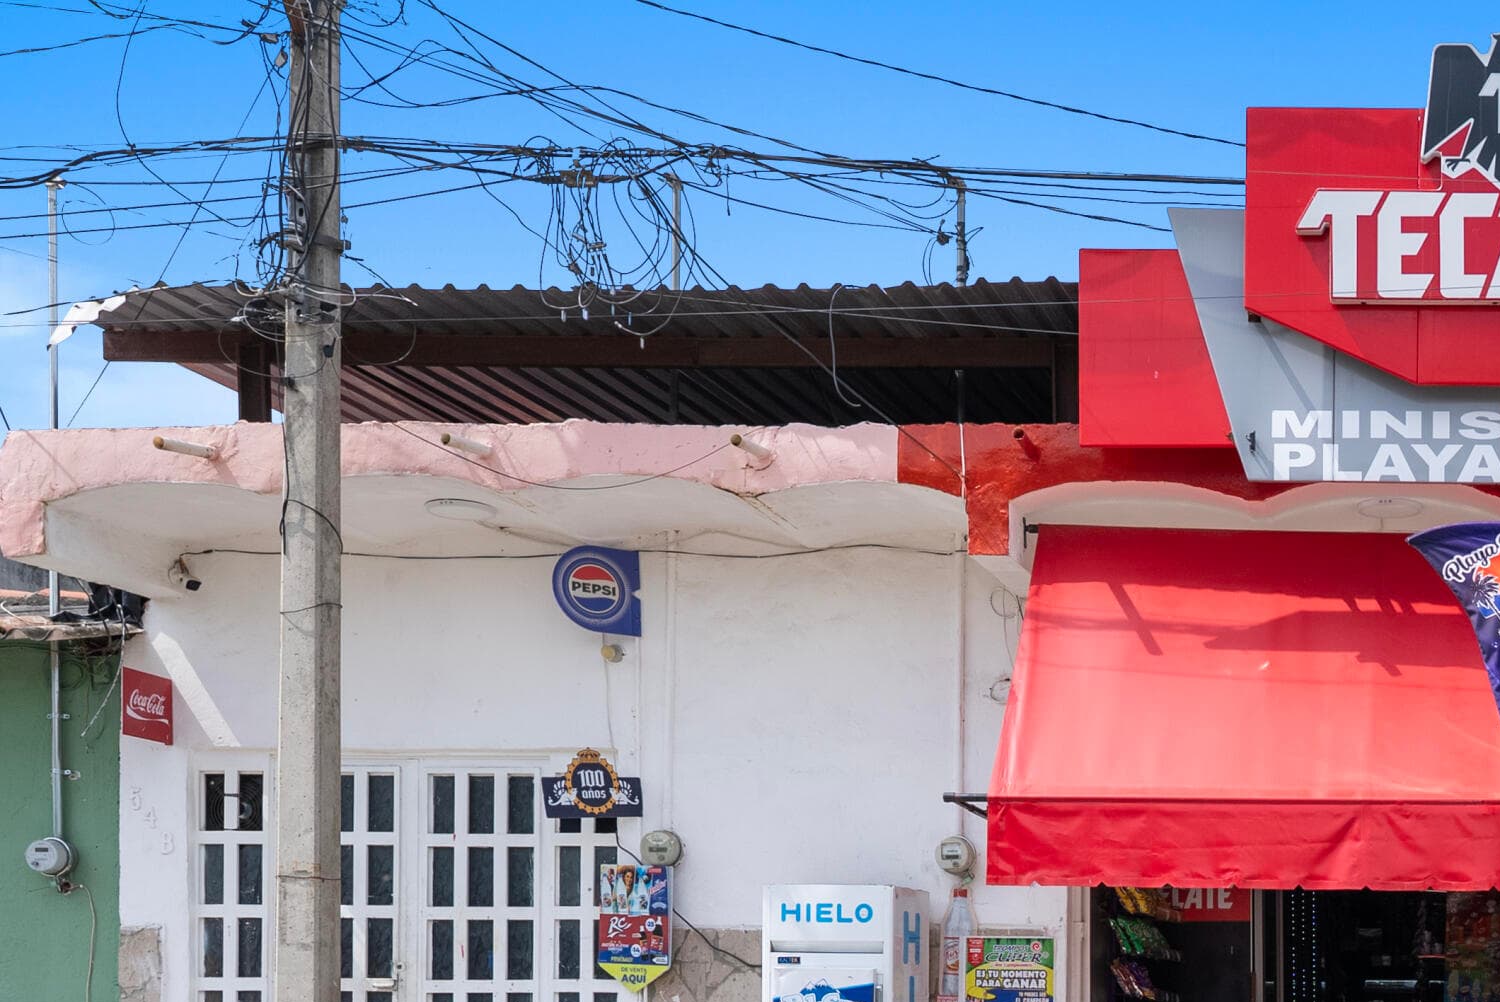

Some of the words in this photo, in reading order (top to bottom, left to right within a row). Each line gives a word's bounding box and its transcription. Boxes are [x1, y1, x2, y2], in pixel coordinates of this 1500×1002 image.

[1443, 544, 1498, 582] Playa
[571, 581, 616, 597] PEPSI
[577, 769, 606, 787] 100
[581, 788, 607, 799] años
[781, 903, 873, 923] HIELO
[608, 916, 632, 937] RC
[1001, 970, 1047, 978] MOMENTO
[976, 979, 1001, 987] PARA
[1003, 979, 1047, 988] GANAR
